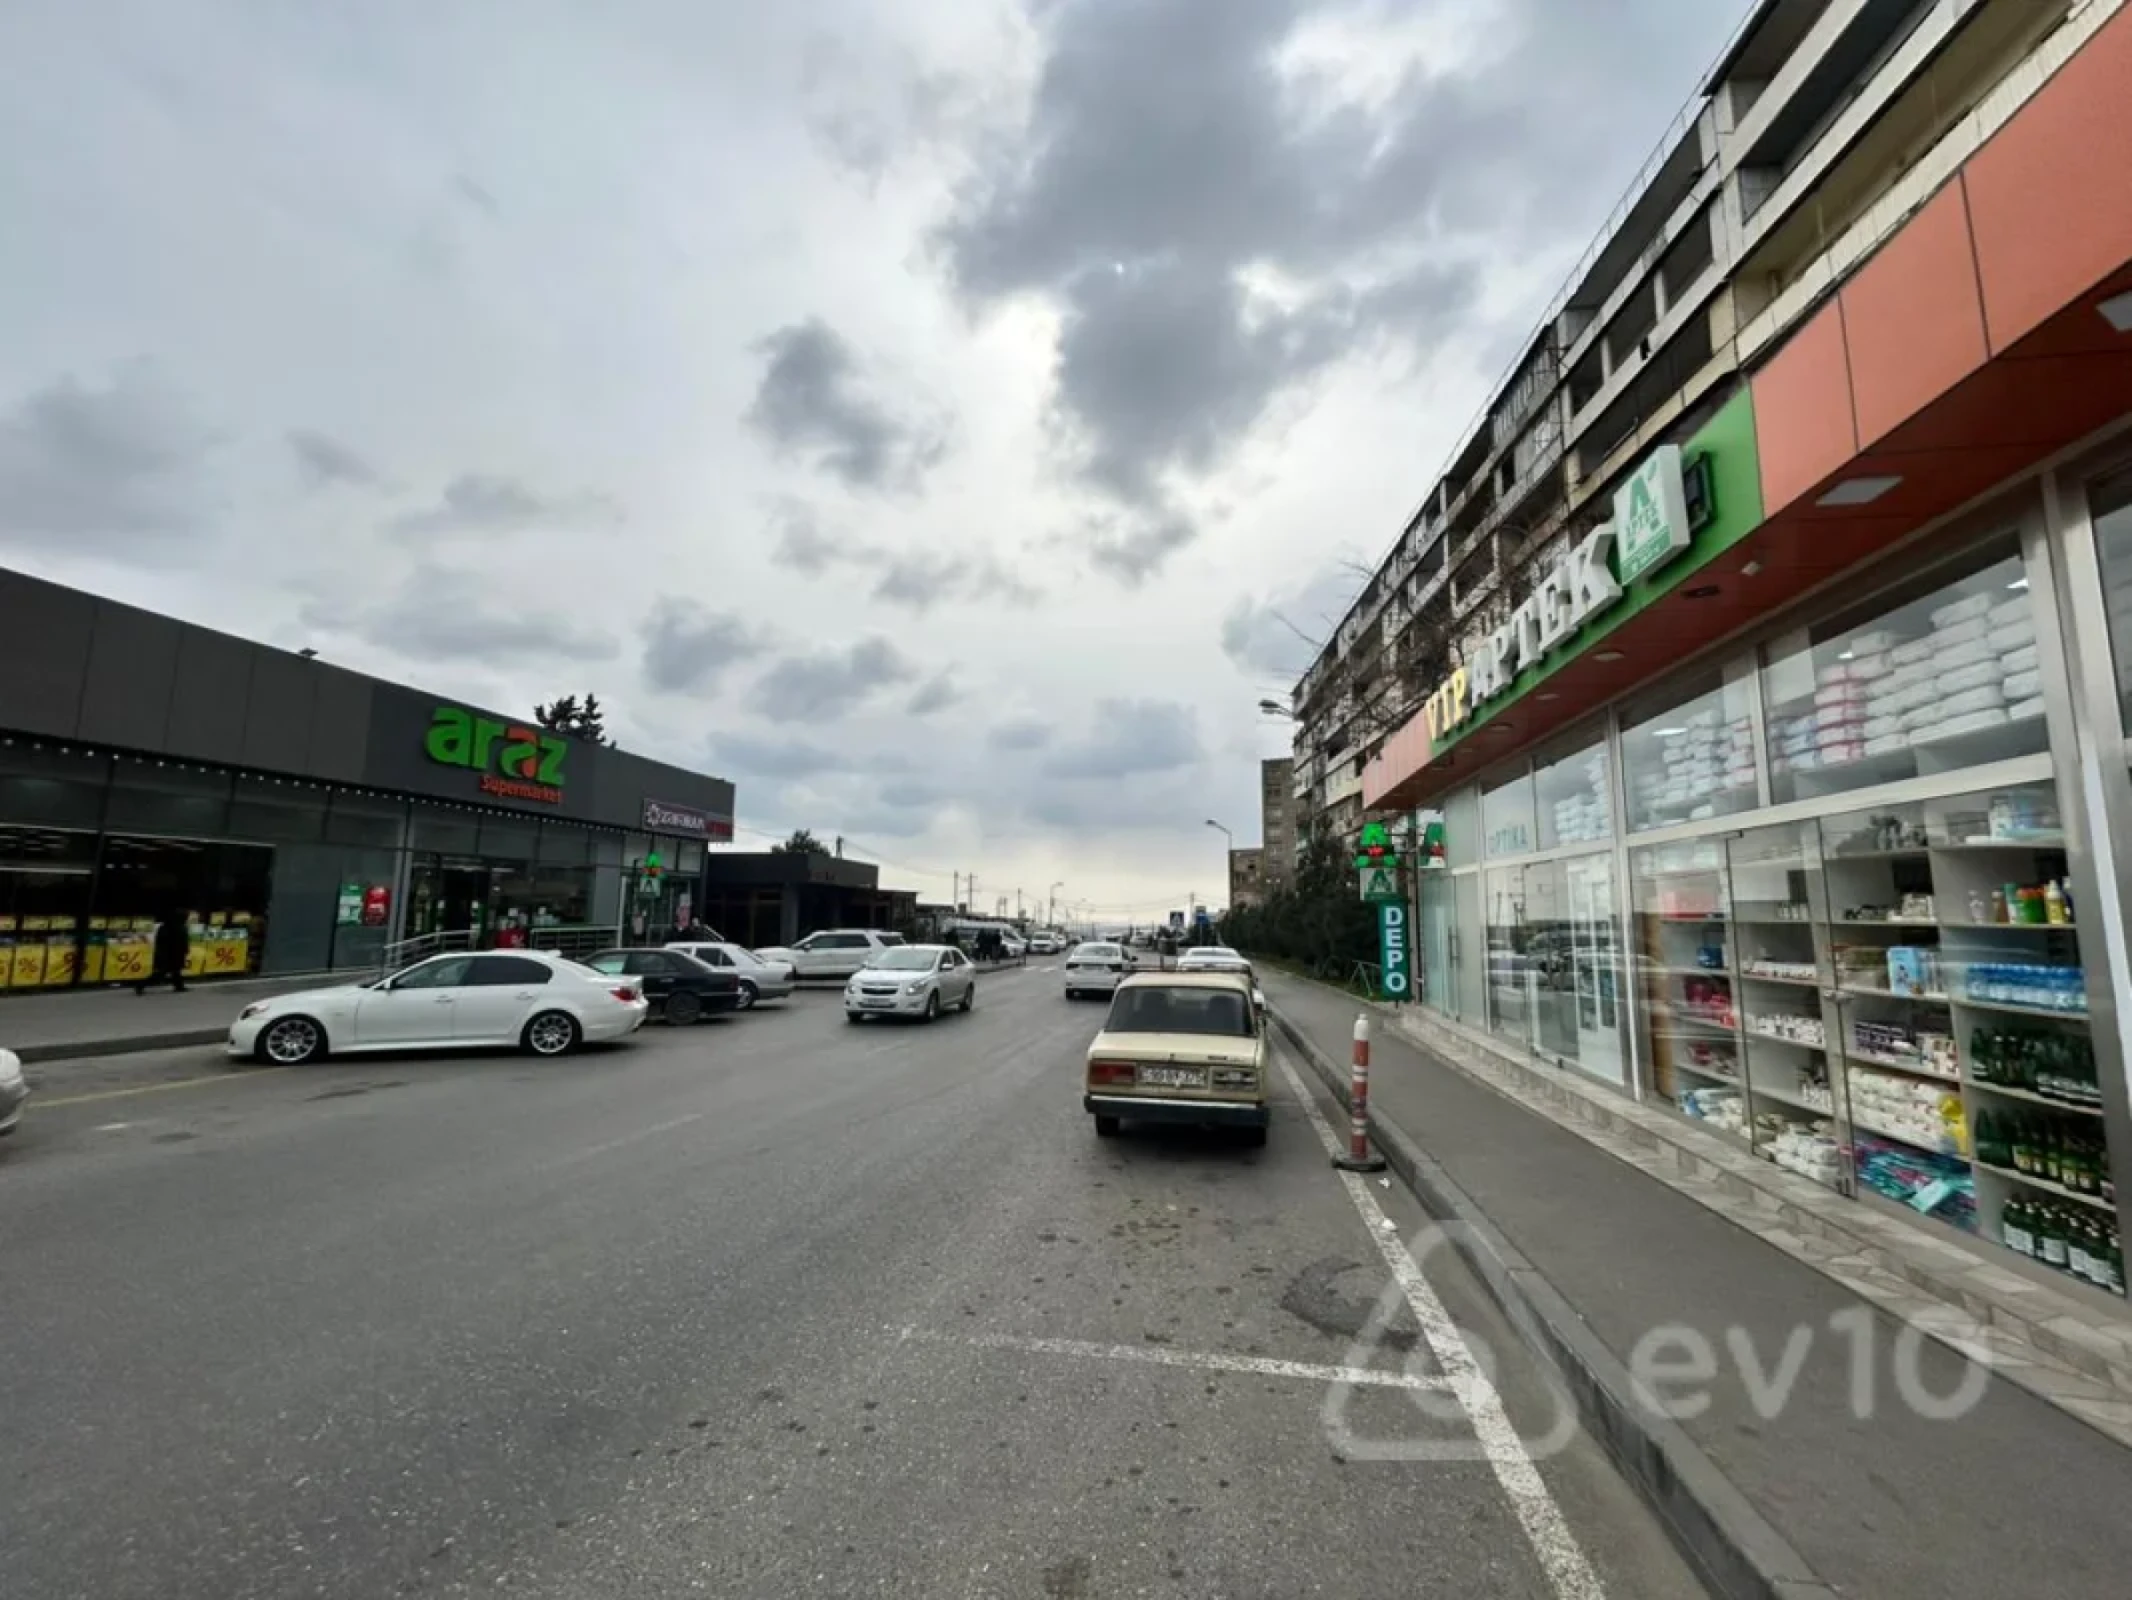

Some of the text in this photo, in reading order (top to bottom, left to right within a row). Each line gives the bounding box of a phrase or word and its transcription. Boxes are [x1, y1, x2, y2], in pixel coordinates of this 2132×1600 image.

[1425, 521, 1620, 740] VIP APTEK
[427, 707, 568, 785] araz
[479, 773, 564, 804] Supermarket
[1385, 907, 1407, 992] DEPO
